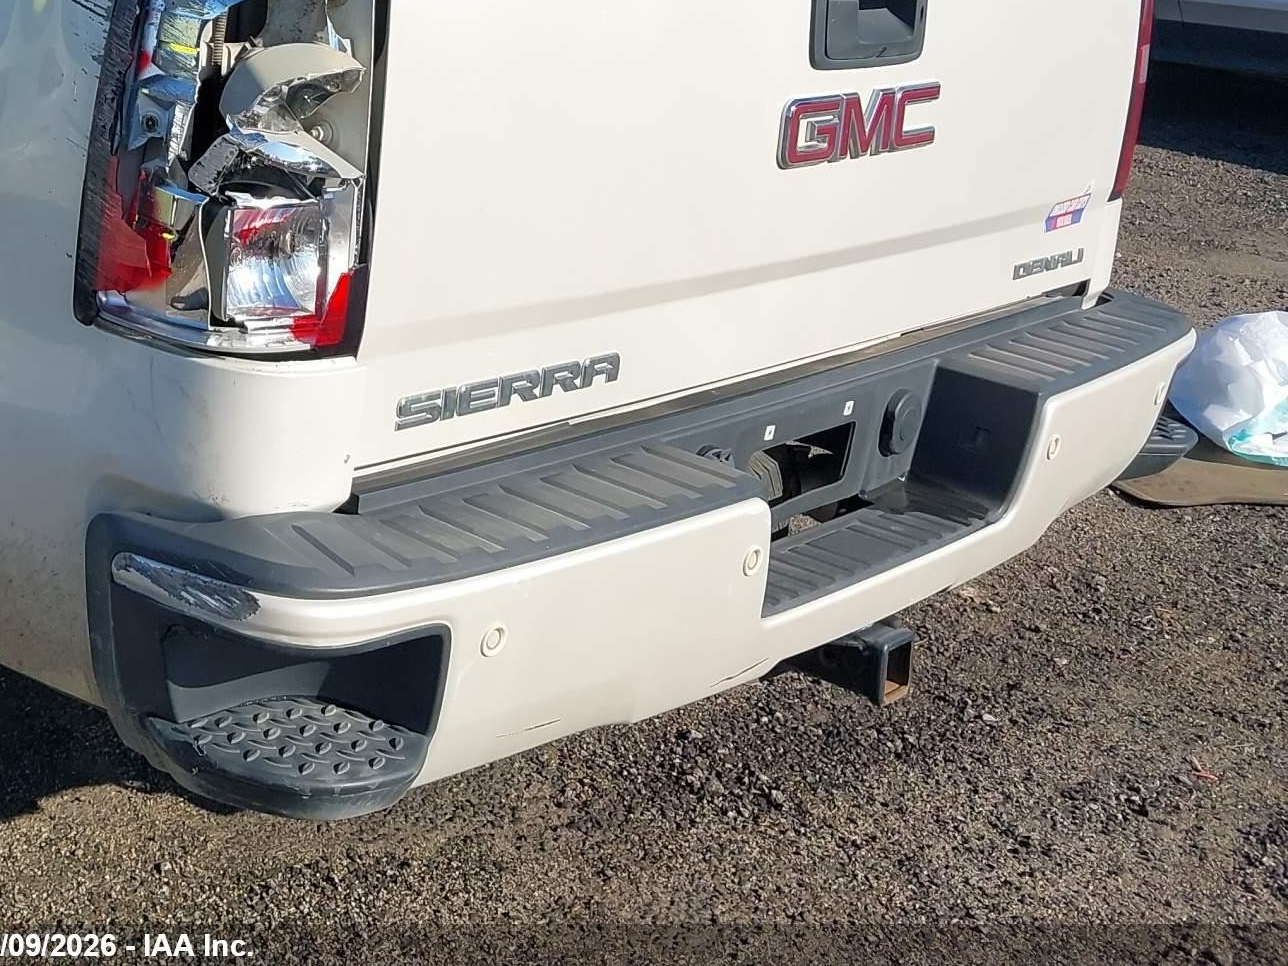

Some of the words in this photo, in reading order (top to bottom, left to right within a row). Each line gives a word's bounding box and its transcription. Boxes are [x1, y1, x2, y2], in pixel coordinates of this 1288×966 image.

[776, 82, 941, 170] GMC
[1013, 248, 1085, 280] DENALI
[394, 352, 621, 432] SIERRA
